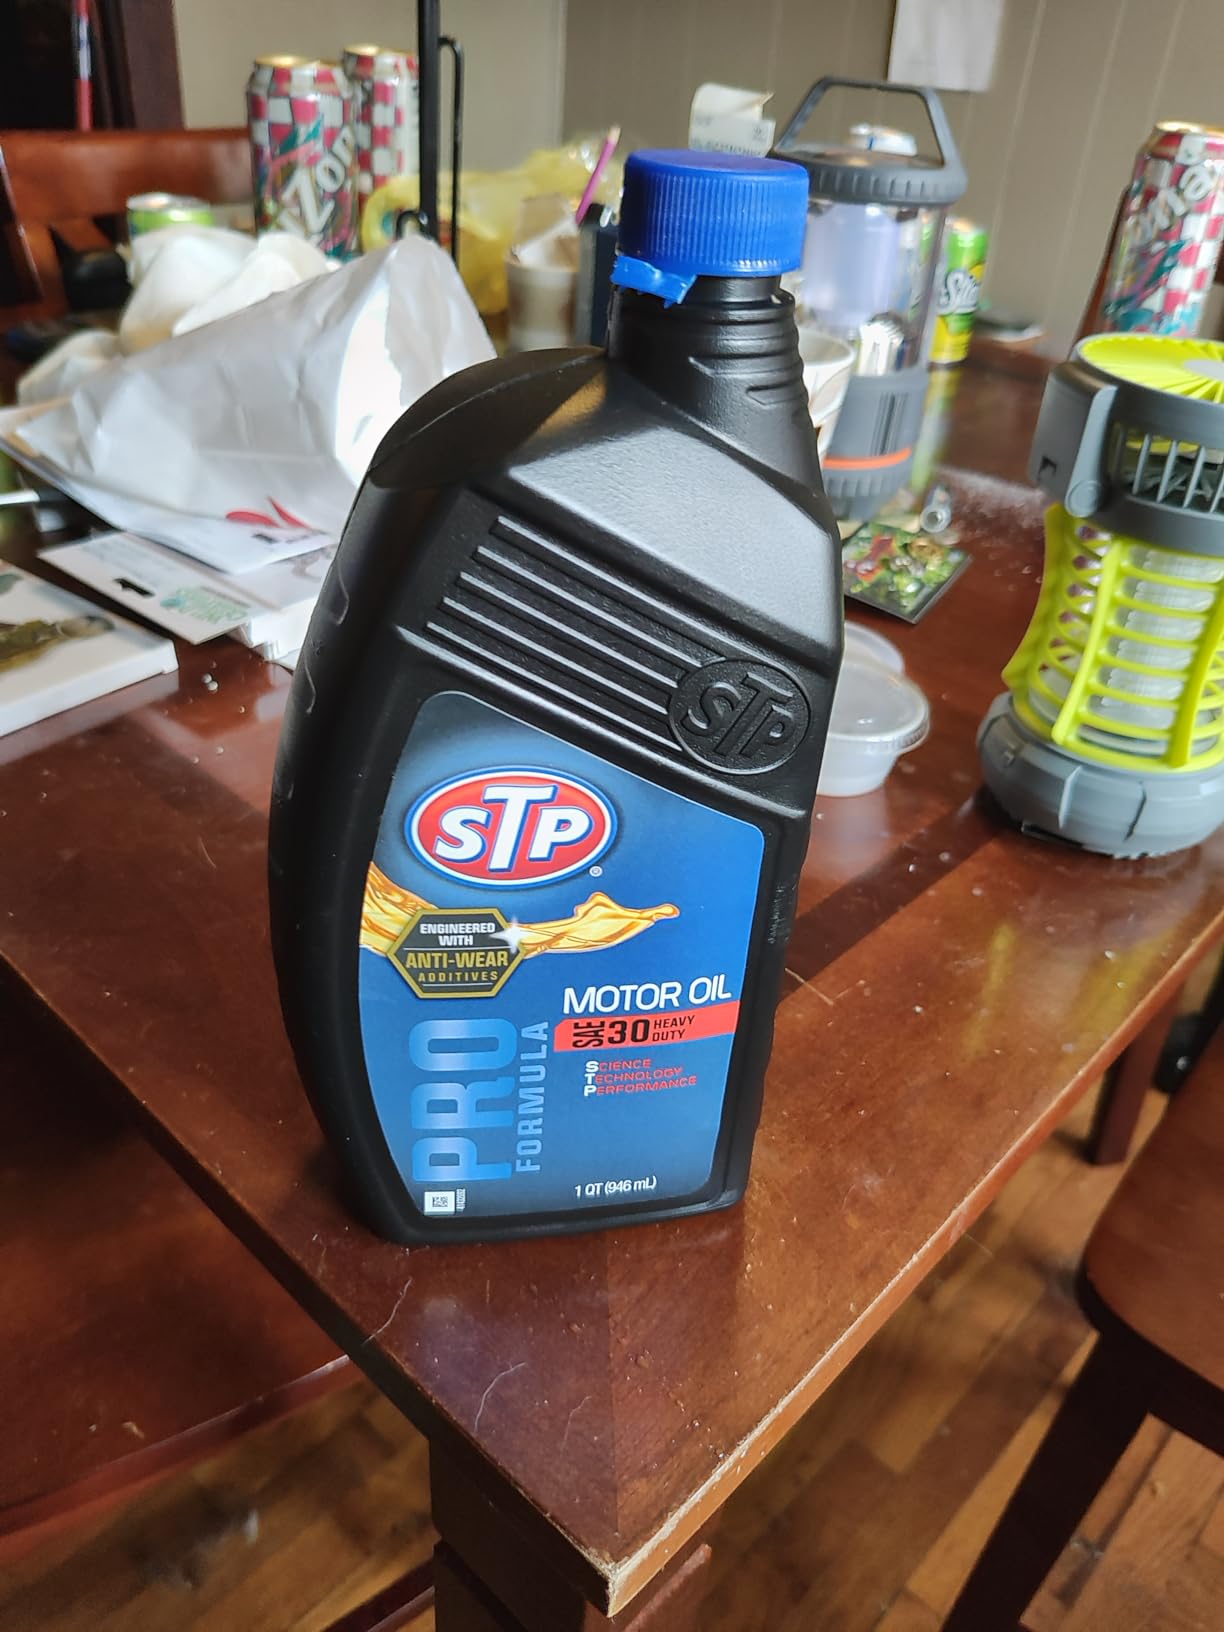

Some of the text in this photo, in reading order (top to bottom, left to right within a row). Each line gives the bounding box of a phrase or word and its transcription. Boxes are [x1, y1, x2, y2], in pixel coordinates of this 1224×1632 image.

[680, 671, 796, 758] STP
[434, 784, 593, 872] STP
[420, 922, 496, 934] ENGINEERED
[438, 935, 474, 946] WITH
[405, 951, 508, 968] ANTI-WEAR
[418, 971, 498, 982] ADDITIVES
[563, 974, 732, 1014] MOTOR OIL
[572, 1015, 696, 1048] SAE 30 HEAVY
[652, 1029, 685, 1042] DUTY
[583, 1067, 684, 1085] TECHNOLOGY
[585, 1058, 653, 1073] SCIENCE
[515, 1021, 550, 1172] FORMULA
[583, 1075, 697, 1097] PERFORMANCE
[409, 1018, 518, 1182] PRO
[575, 1175, 657, 1198] 1 QT (946 mL)
